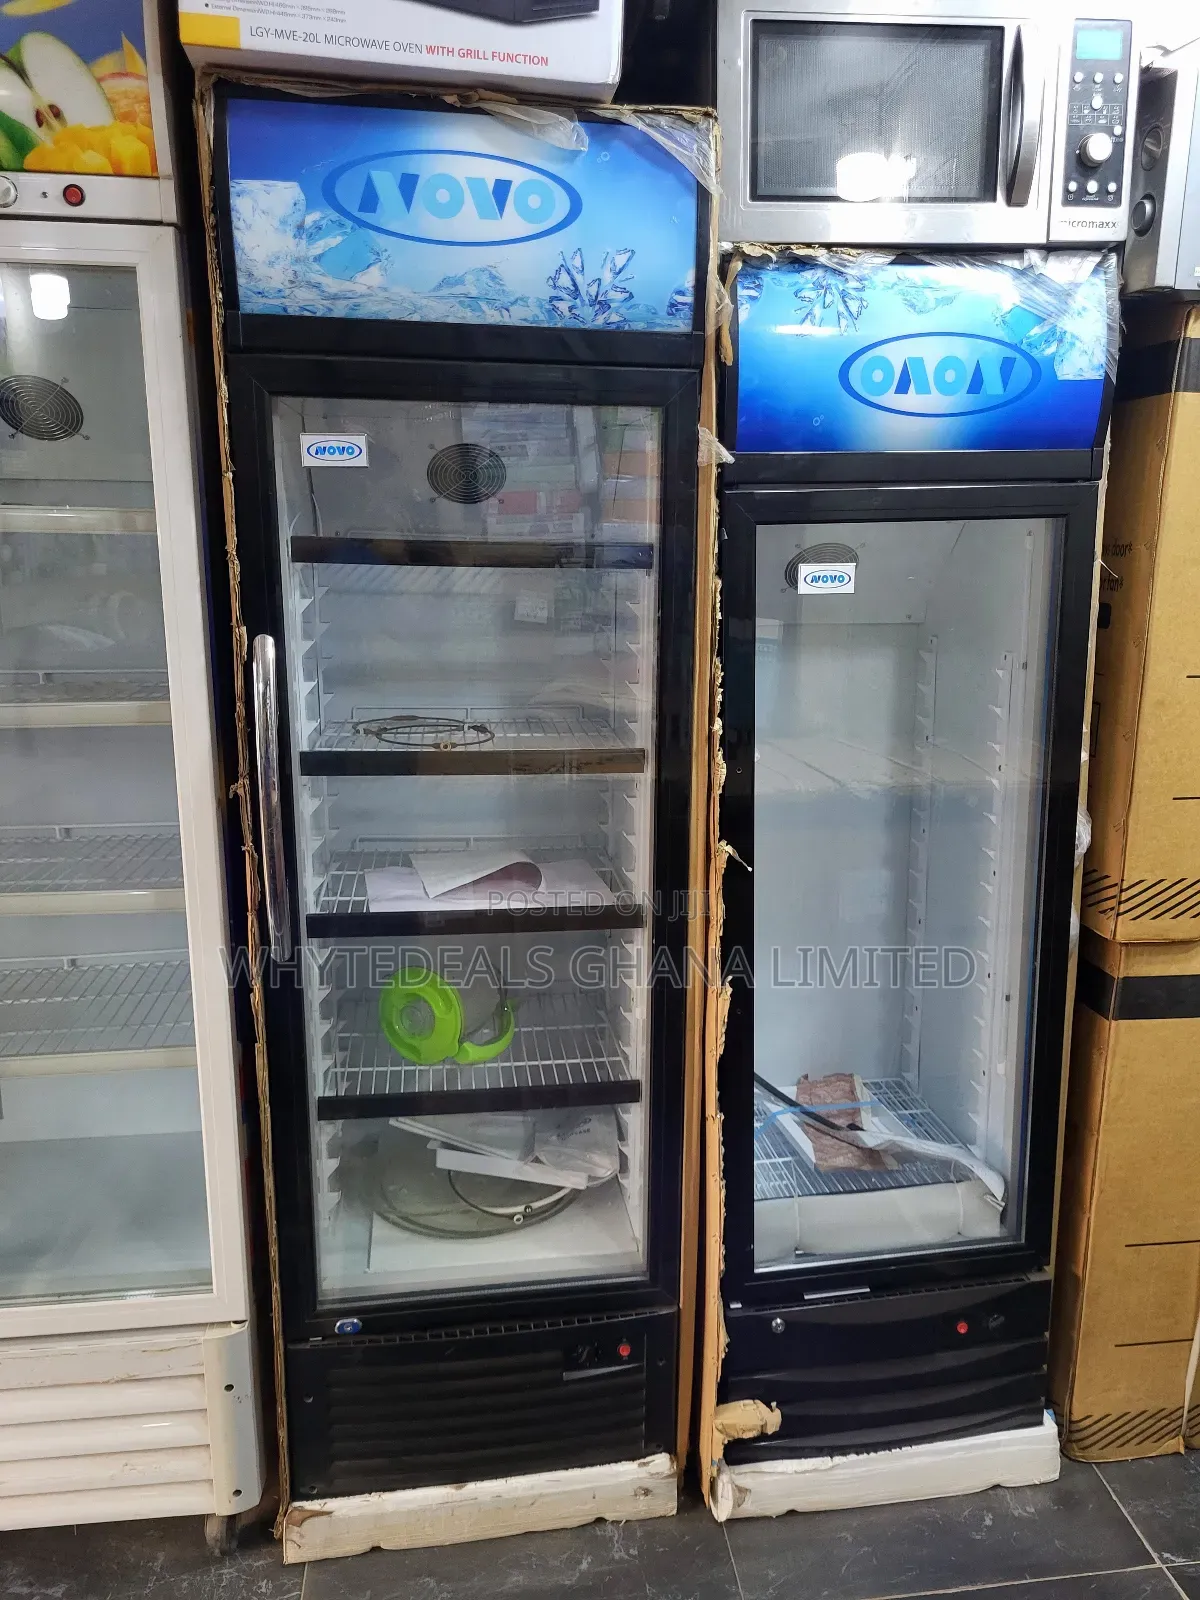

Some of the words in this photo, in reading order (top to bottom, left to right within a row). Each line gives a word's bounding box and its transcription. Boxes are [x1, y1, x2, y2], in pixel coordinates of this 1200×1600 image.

[250, 25, 322, 44] LGY-MVE-20L
[324, 34, 390, 51] MICROWAVE
[392, 41, 423, 54] OVEN
[425, 44, 455, 57] WITH
[457, 48, 489, 61] GRILL
[491, 51, 549, 66] FUNCTION
[357, 170, 556, 225] NOVO
[314, 445, 355, 456] NOVO
[810, 574, 845, 584] NOVO
